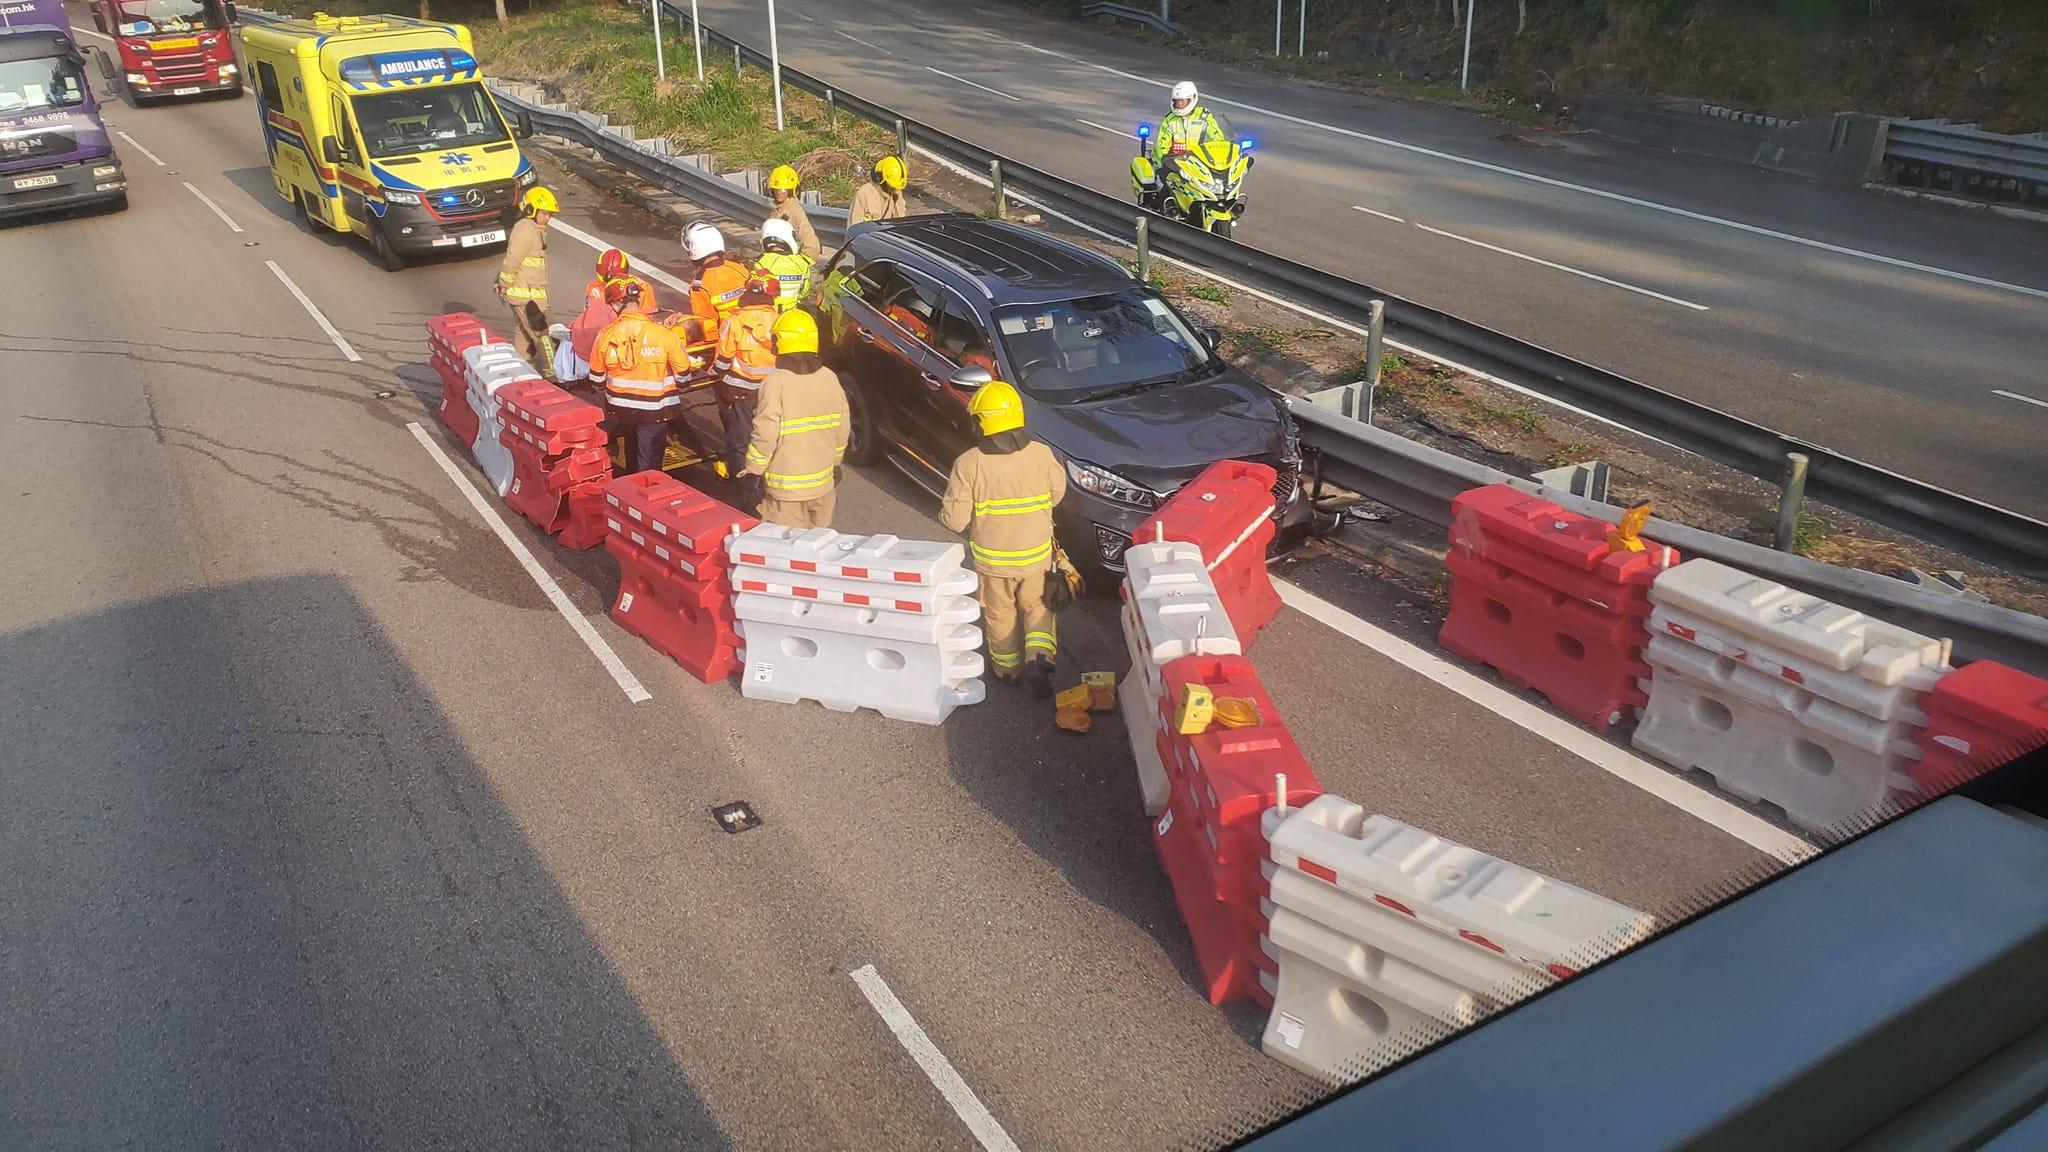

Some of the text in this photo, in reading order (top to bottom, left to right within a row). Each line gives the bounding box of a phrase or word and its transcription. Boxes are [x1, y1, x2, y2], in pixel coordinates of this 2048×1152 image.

[381, 58, 446, 75] AMBULANCE
[23, 114, 45, 125] 2468
[2, 138, 42, 151] MAN
[472, 233, 496, 244] A 180
